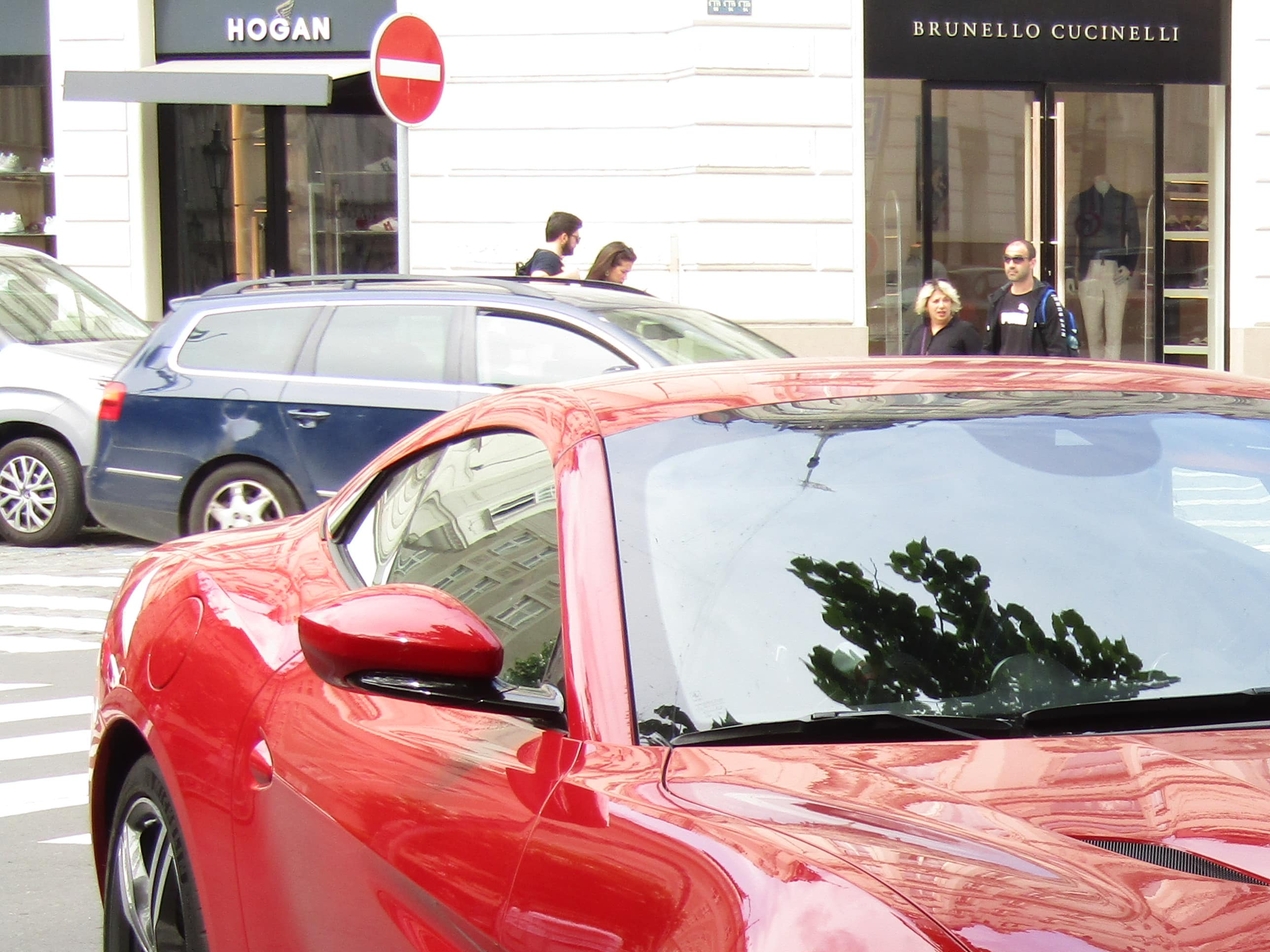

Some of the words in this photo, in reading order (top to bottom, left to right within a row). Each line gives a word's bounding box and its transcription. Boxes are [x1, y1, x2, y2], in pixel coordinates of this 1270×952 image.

[227, 17, 331, 42] HOGAN
[913, 21, 1041, 39] BRUNELLO
[1051, 24, 1179, 42] CUCINELLI
